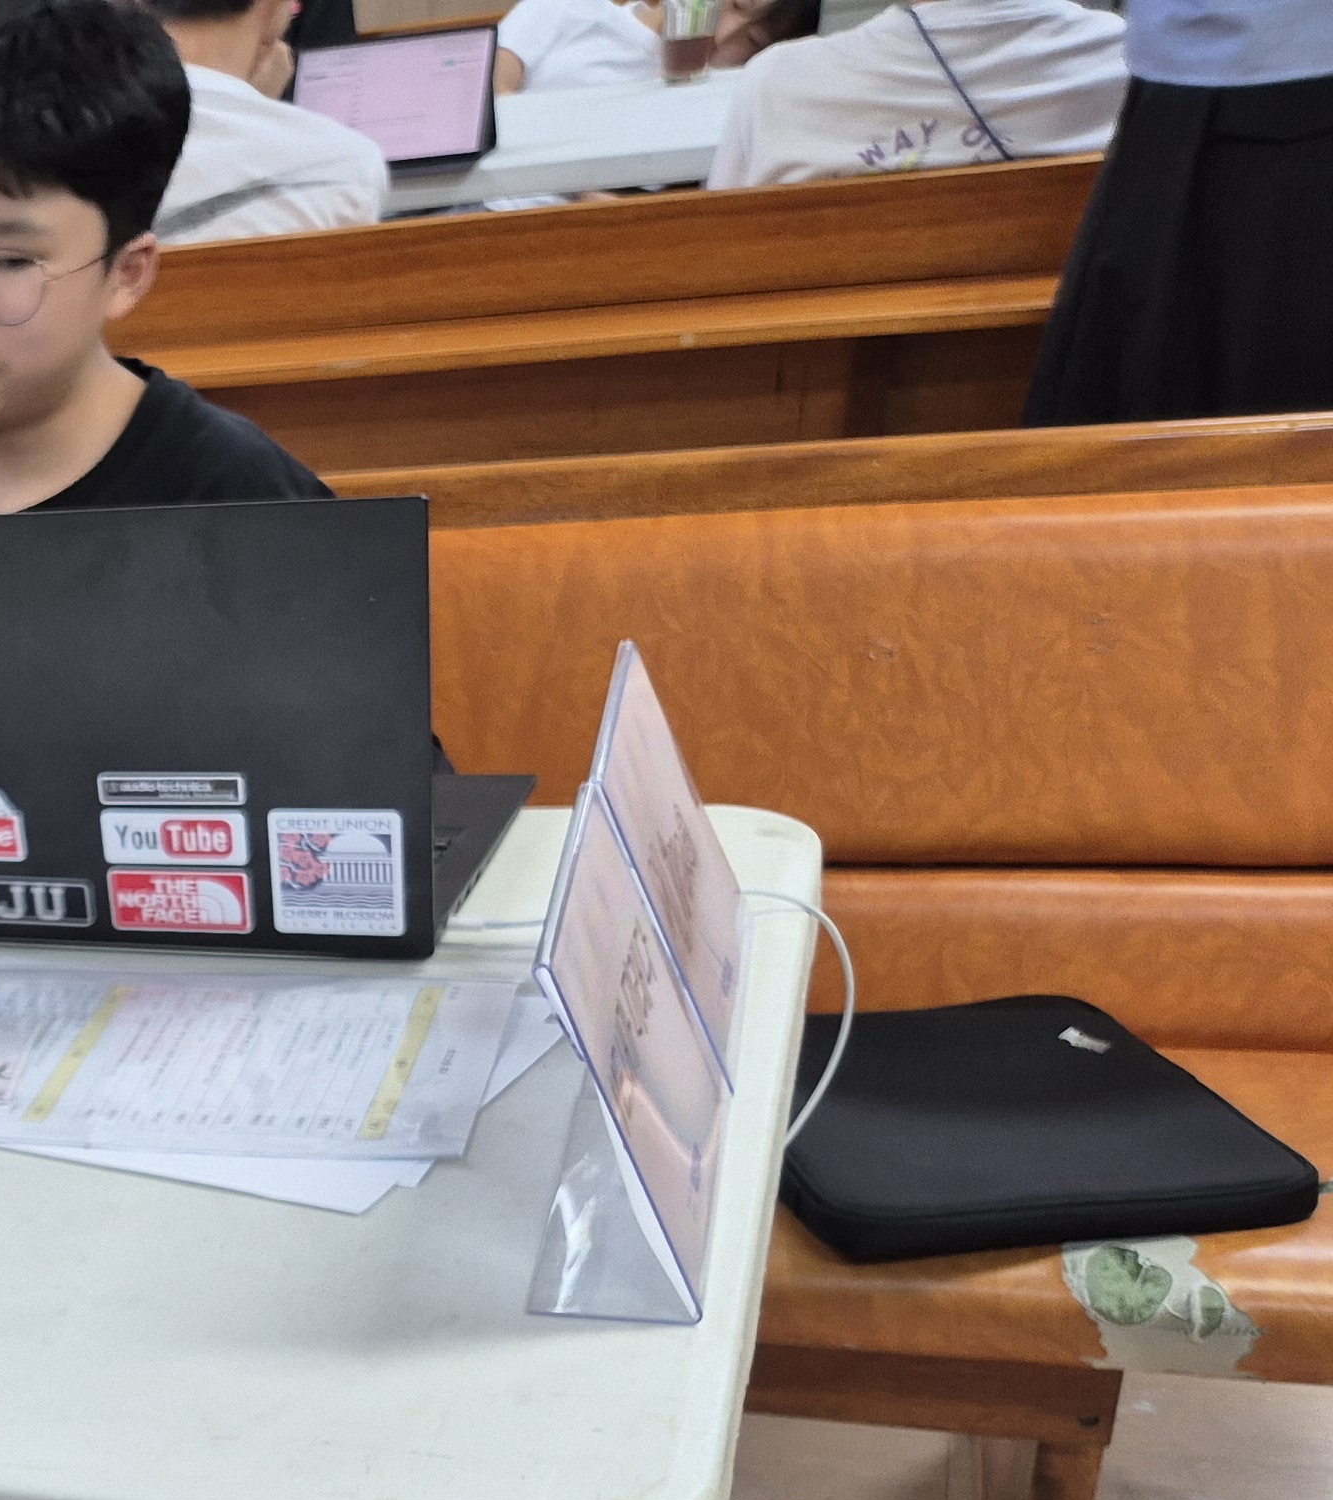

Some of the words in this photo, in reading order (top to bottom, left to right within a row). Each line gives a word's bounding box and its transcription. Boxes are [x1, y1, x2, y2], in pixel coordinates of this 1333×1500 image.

[858, 119, 938, 167] WAY
[275, 819, 331, 830] CREDIT
[334, 819, 391, 831] UNION
[150, 879, 197, 894] THE
[117, 892, 199, 909] NORTH
[141, 907, 203, 924] FACE
[333, 911, 394, 920] BLOSSOM
